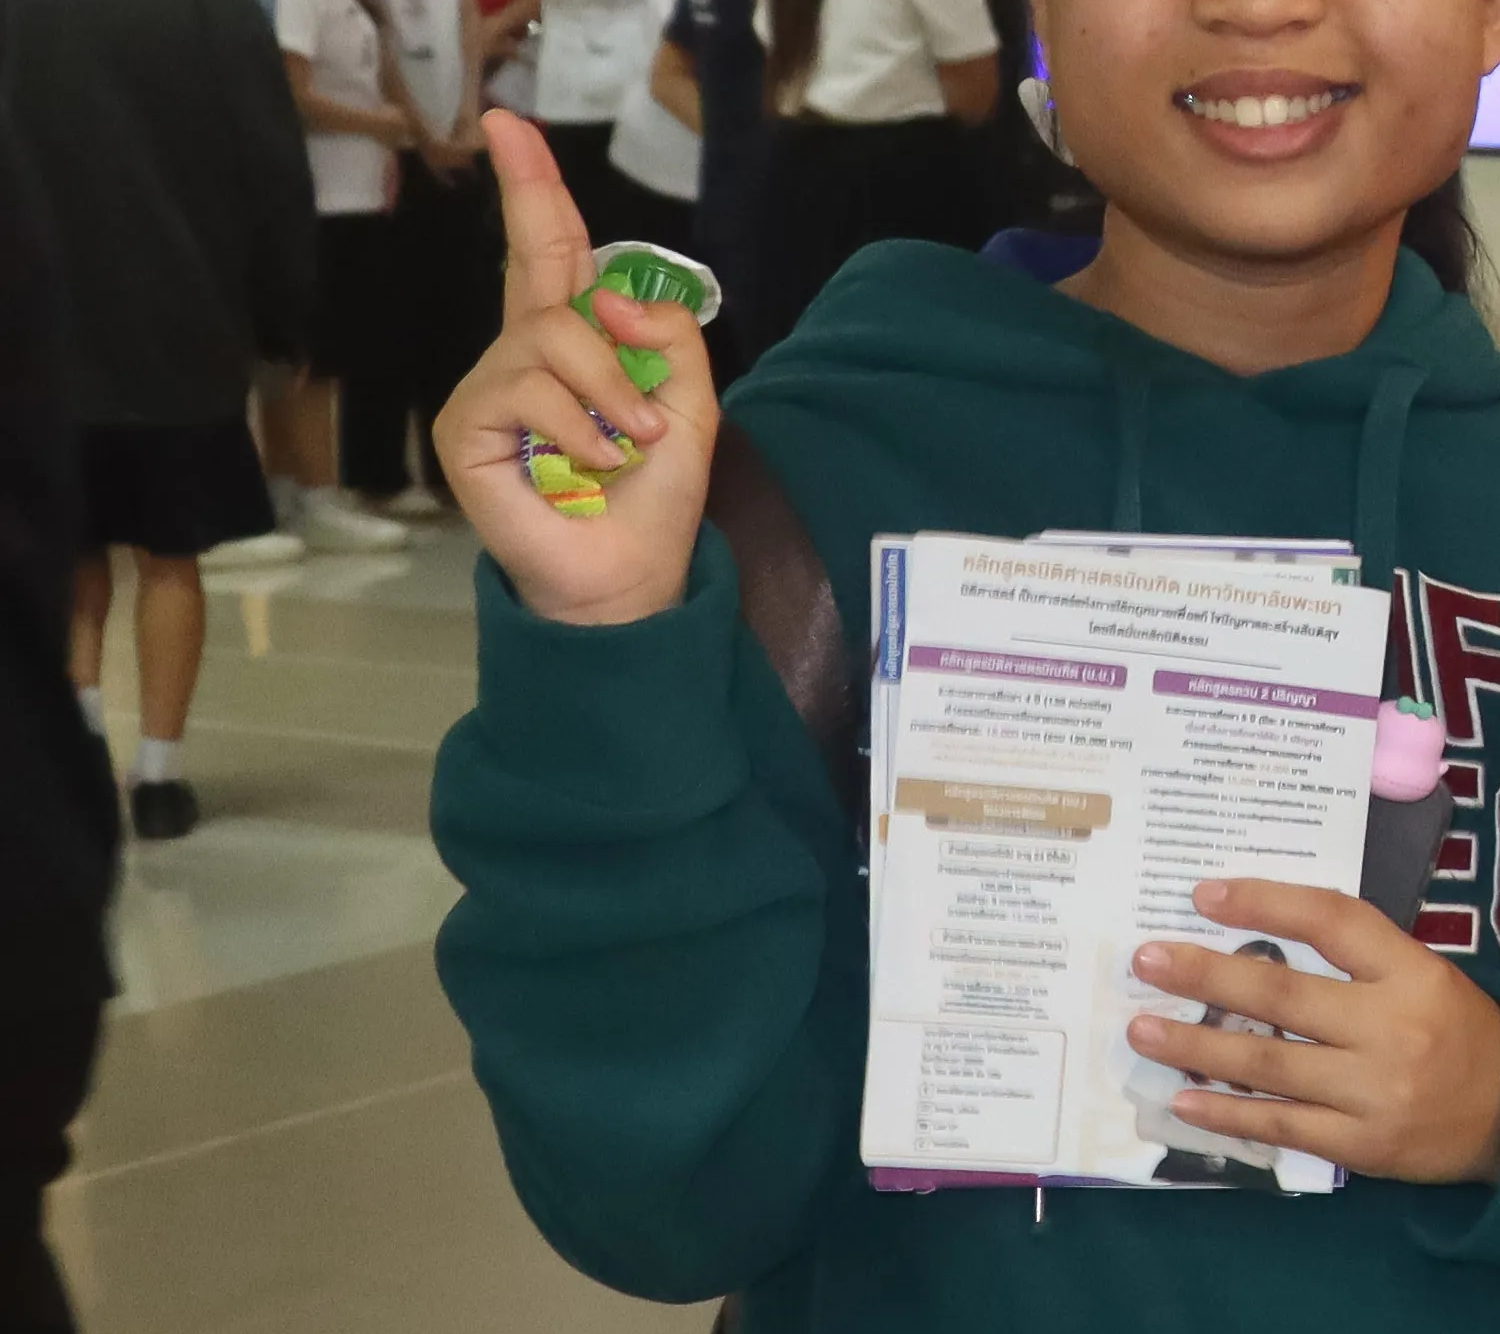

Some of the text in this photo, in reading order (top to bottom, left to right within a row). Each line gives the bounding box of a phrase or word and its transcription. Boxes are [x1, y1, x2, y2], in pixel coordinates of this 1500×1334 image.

[962, 554, 1342, 617] หลักสูตรนิติศาสตรบัณฑิต มหาวิทยาลัยพะเยา
